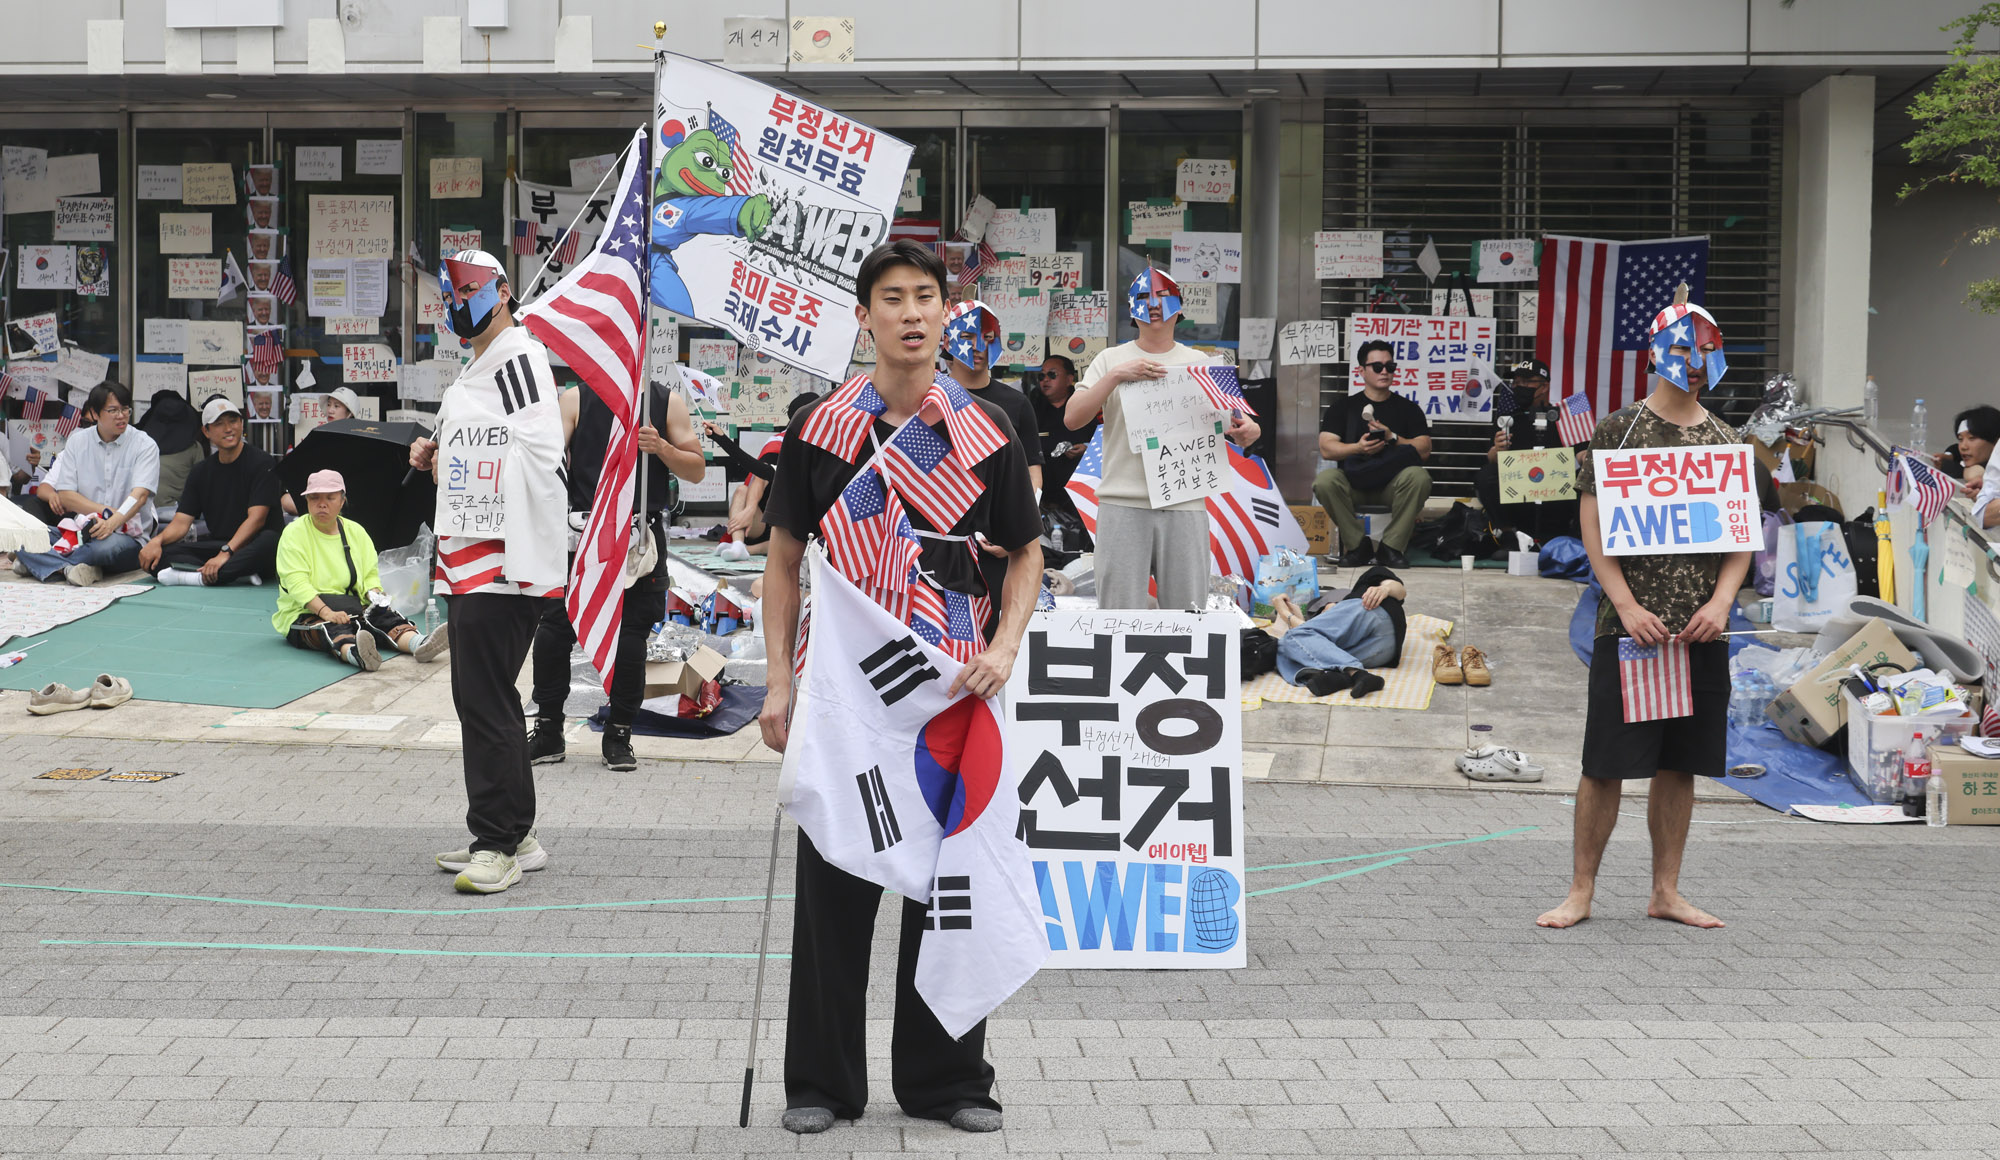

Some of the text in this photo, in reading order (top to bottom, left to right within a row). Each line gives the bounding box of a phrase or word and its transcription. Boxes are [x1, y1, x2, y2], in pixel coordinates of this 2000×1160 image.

[728, 29, 780, 48] 재선거
[768, 93, 876, 163] 부정선거
[757, 126, 867, 197] 원천무효
[315, 200, 392, 216] 투표용지 지키자!
[328, 217, 370, 233] 증거보존
[315, 238, 389, 255] 부정선거 진상규명
[443, 233, 481, 251] 재선거
[762, 198, 888, 279] AWEB
[793, 254, 812, 270] World
[811, 263, 837, 283] Election
[837, 275, 858, 293] Bodie
[1029, 256, 1075, 269] 최소상주
[730, 260, 824, 328] 한미공조
[1080, 290, 1108, 310] 수개표
[724, 290, 813, 357] 국제수사
[1084, 307, 1107, 324] 금지
[336, 320, 368, 335] 부정선거
[1285, 323, 1336, 345] 부정선거
[1354, 316, 1422, 338] 국제기관
[1426, 319, 1467, 341] 꼬리
[345, 346, 375, 361] 투표용지
[652, 344, 673, 355] WEB
[1290, 345, 1337, 359] A-WEB
[1427, 342, 1492, 364] 선관위
[354, 359, 393, 371] 지킵시다!
[1427, 370, 1469, 391] 몸통
[1180, 393, 1208, 409] 증거보
[449, 426, 510, 448] AWEB
[1159, 434, 1217, 461] A-WEB
[449, 456, 502, 494] 한미
[1158, 452, 1217, 480] 부정선거
[1602, 451, 1750, 499] 부정선거
[1161, 470, 1218, 501] 증거보존
[448, 494, 506, 511] 공조수사
[1607, 501, 1723, 549] AWEB
[1727, 499, 1751, 544] 에이웹
[1016, 630, 1227, 756] 부정
[1083, 726, 1135, 752] 부정선거
[1014, 749, 1233, 858] 선거
[1149, 842, 1208, 864] 에이웹
